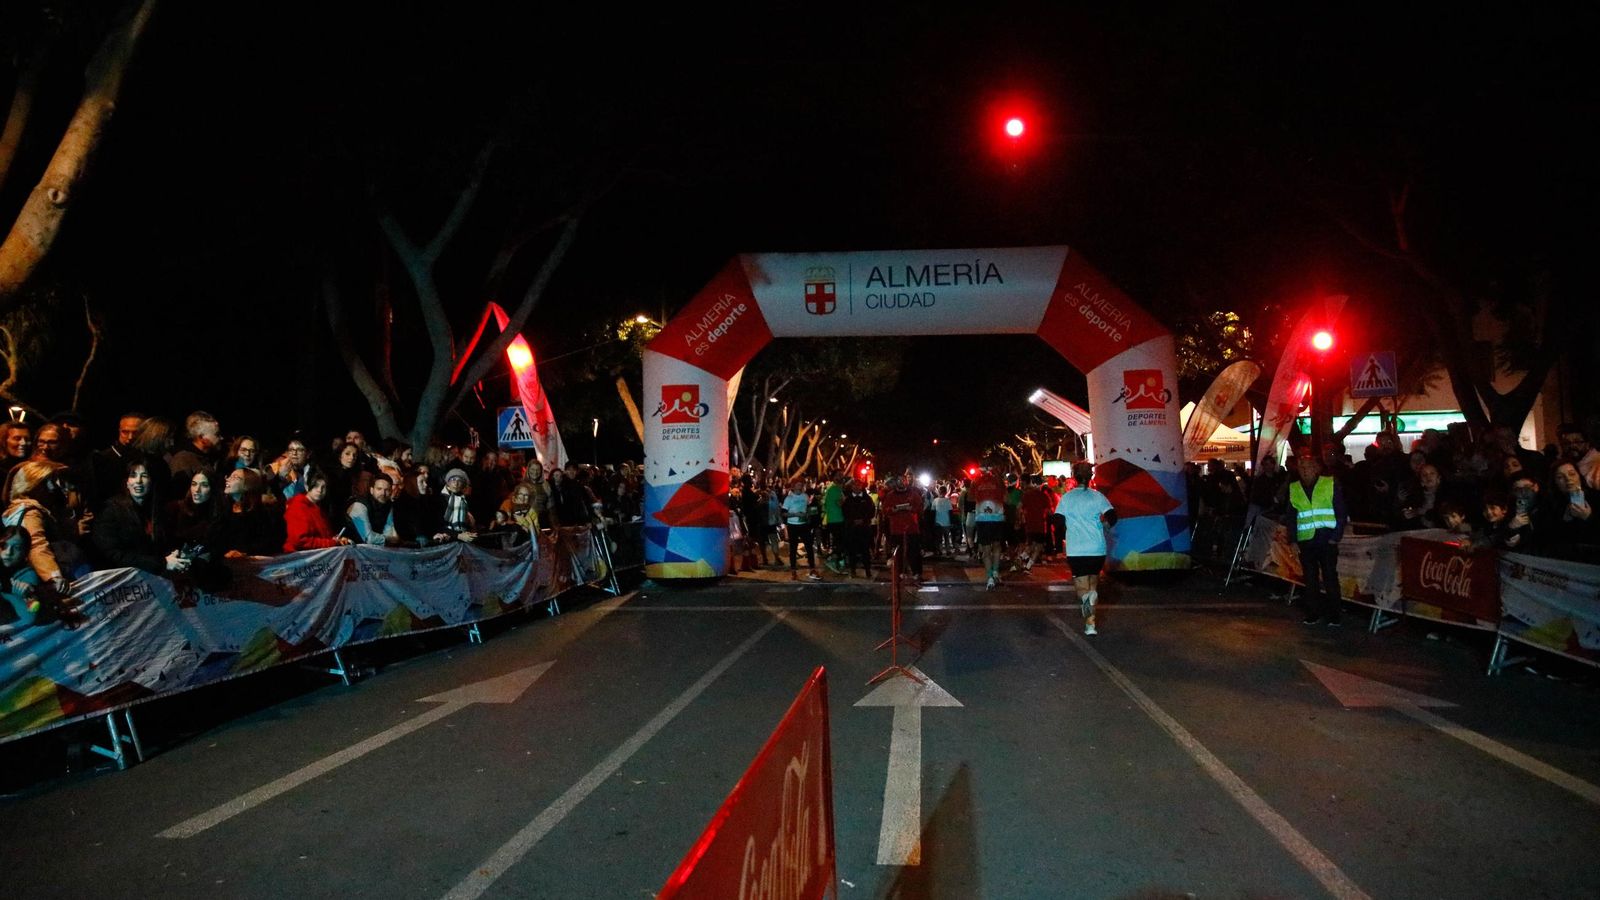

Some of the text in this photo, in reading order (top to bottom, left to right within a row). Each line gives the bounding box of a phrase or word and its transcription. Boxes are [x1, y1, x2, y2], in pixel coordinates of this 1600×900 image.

[866, 259, 1004, 289] ALMERÍA
[866, 292, 936, 309] CIUDAD
[684, 293, 736, 347] ALMERÍA
[694, 303, 748, 356] es deporte
[1064, 293, 1123, 342] es deporte
[662, 427, 701, 435] DEPORTES
[1127, 413, 1167, 421] DEPORTES
